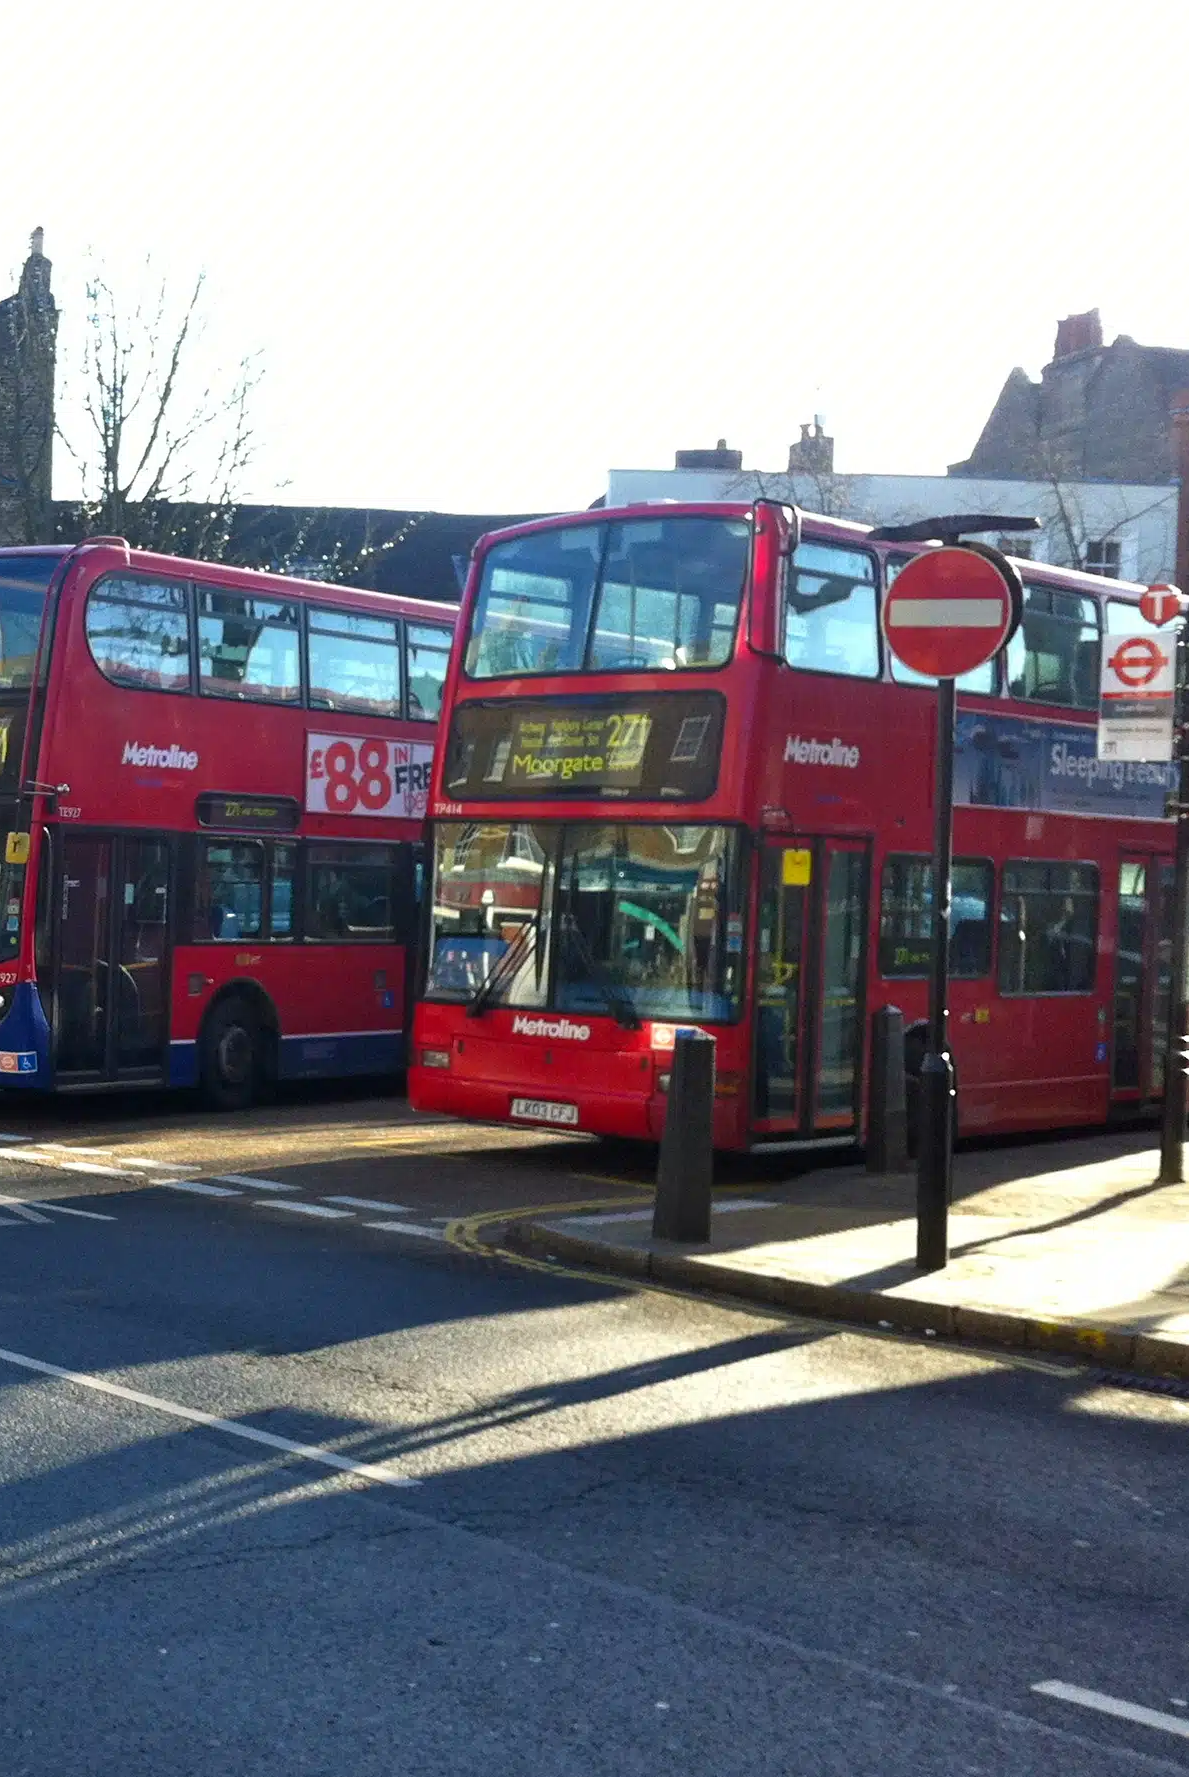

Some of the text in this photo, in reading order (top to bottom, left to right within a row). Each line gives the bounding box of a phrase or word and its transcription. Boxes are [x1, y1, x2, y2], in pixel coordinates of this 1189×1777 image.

[606, 713, 650, 748] 271
[122, 740, 199, 770] Metroline
[394, 746, 408, 765] IN
[784, 733, 860, 768] Metroline
[513, 754, 604, 780] Moorgate
[59, 806, 81, 818] TE927
[434, 803, 463, 815] TP414
[512, 1015, 591, 1041] Metroline
